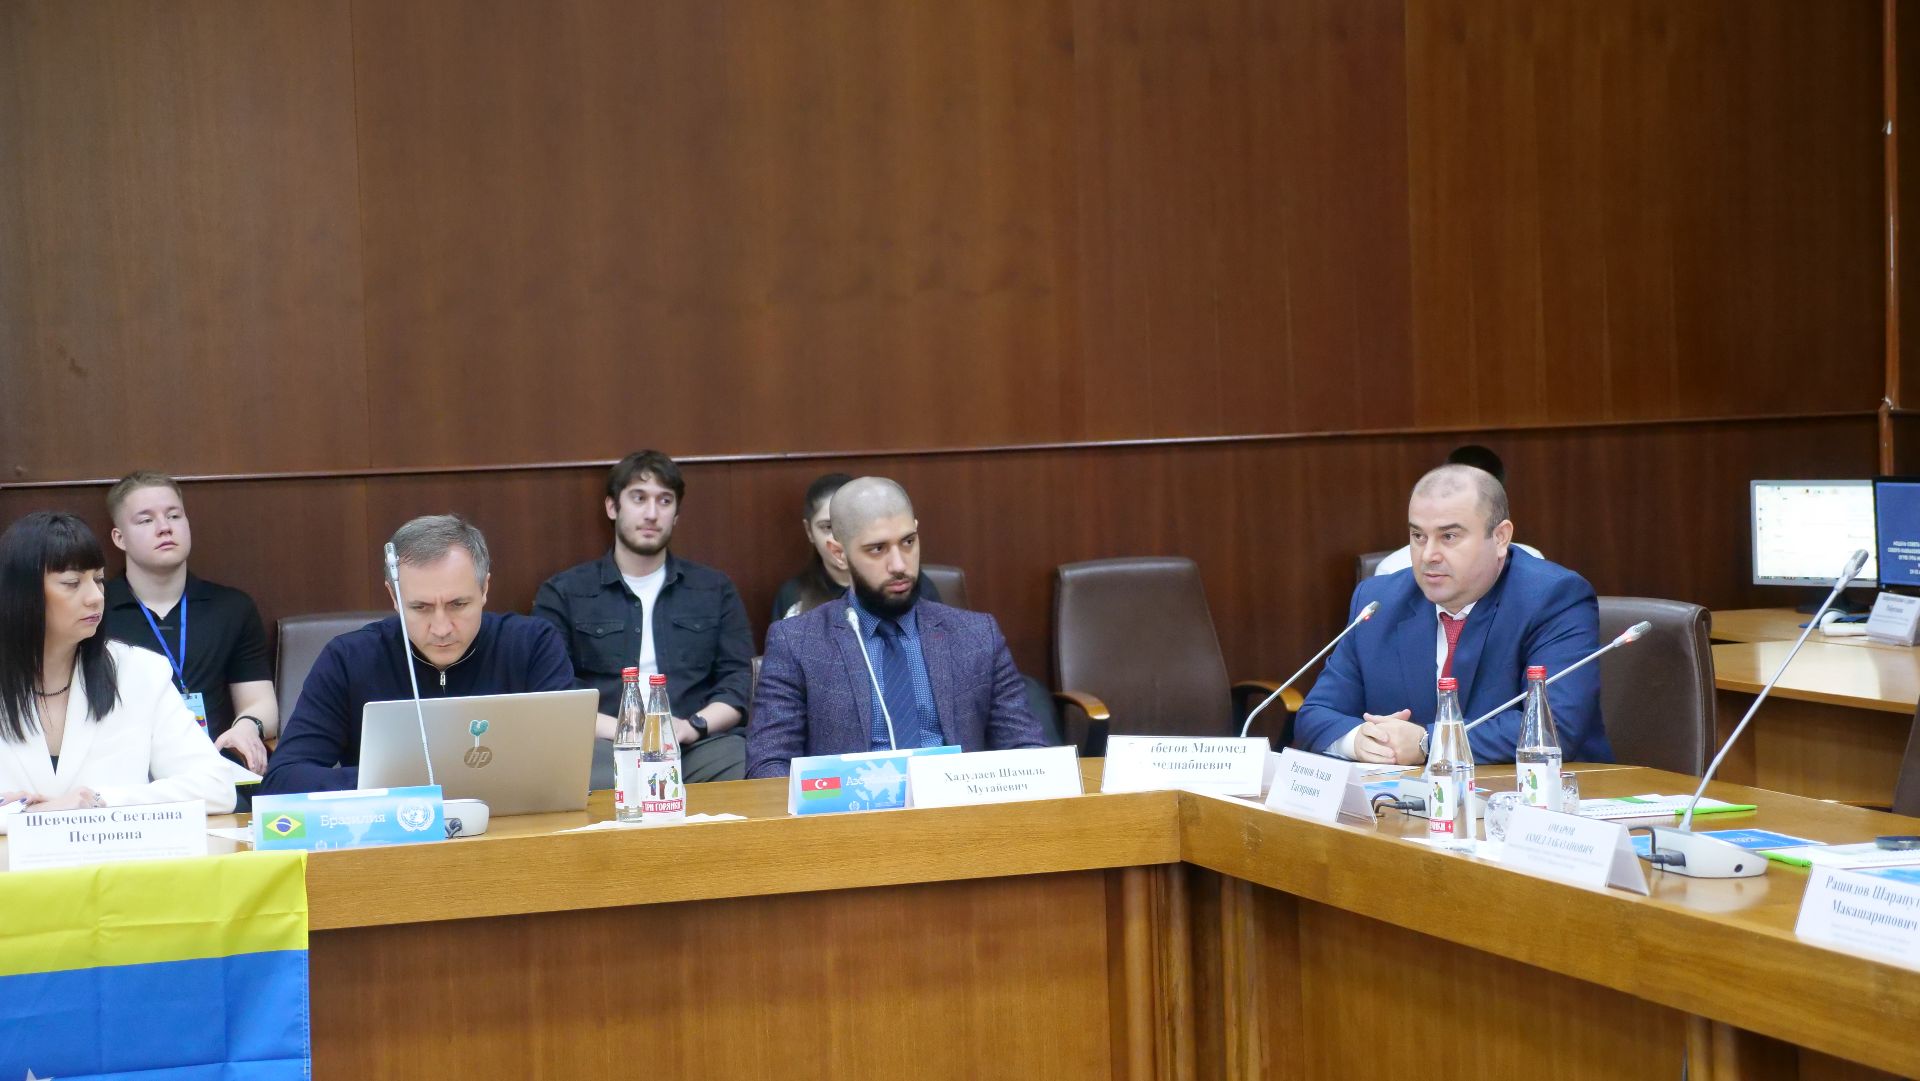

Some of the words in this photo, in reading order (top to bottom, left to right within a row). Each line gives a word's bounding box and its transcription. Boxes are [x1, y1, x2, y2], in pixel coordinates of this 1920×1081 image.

[1192, 742, 1248, 754] Магомед
[944, 771, 996, 784] Хадулаев
[998, 767, 1046, 779] Шамиль
[26, 814, 106, 827] Шевченко
[110, 809, 183, 823] Светлана
[69, 829, 143, 845] Петровна
[1825, 875, 1870, 897] Рашидов
[1833, 899, 1918, 931] Макашарипович
